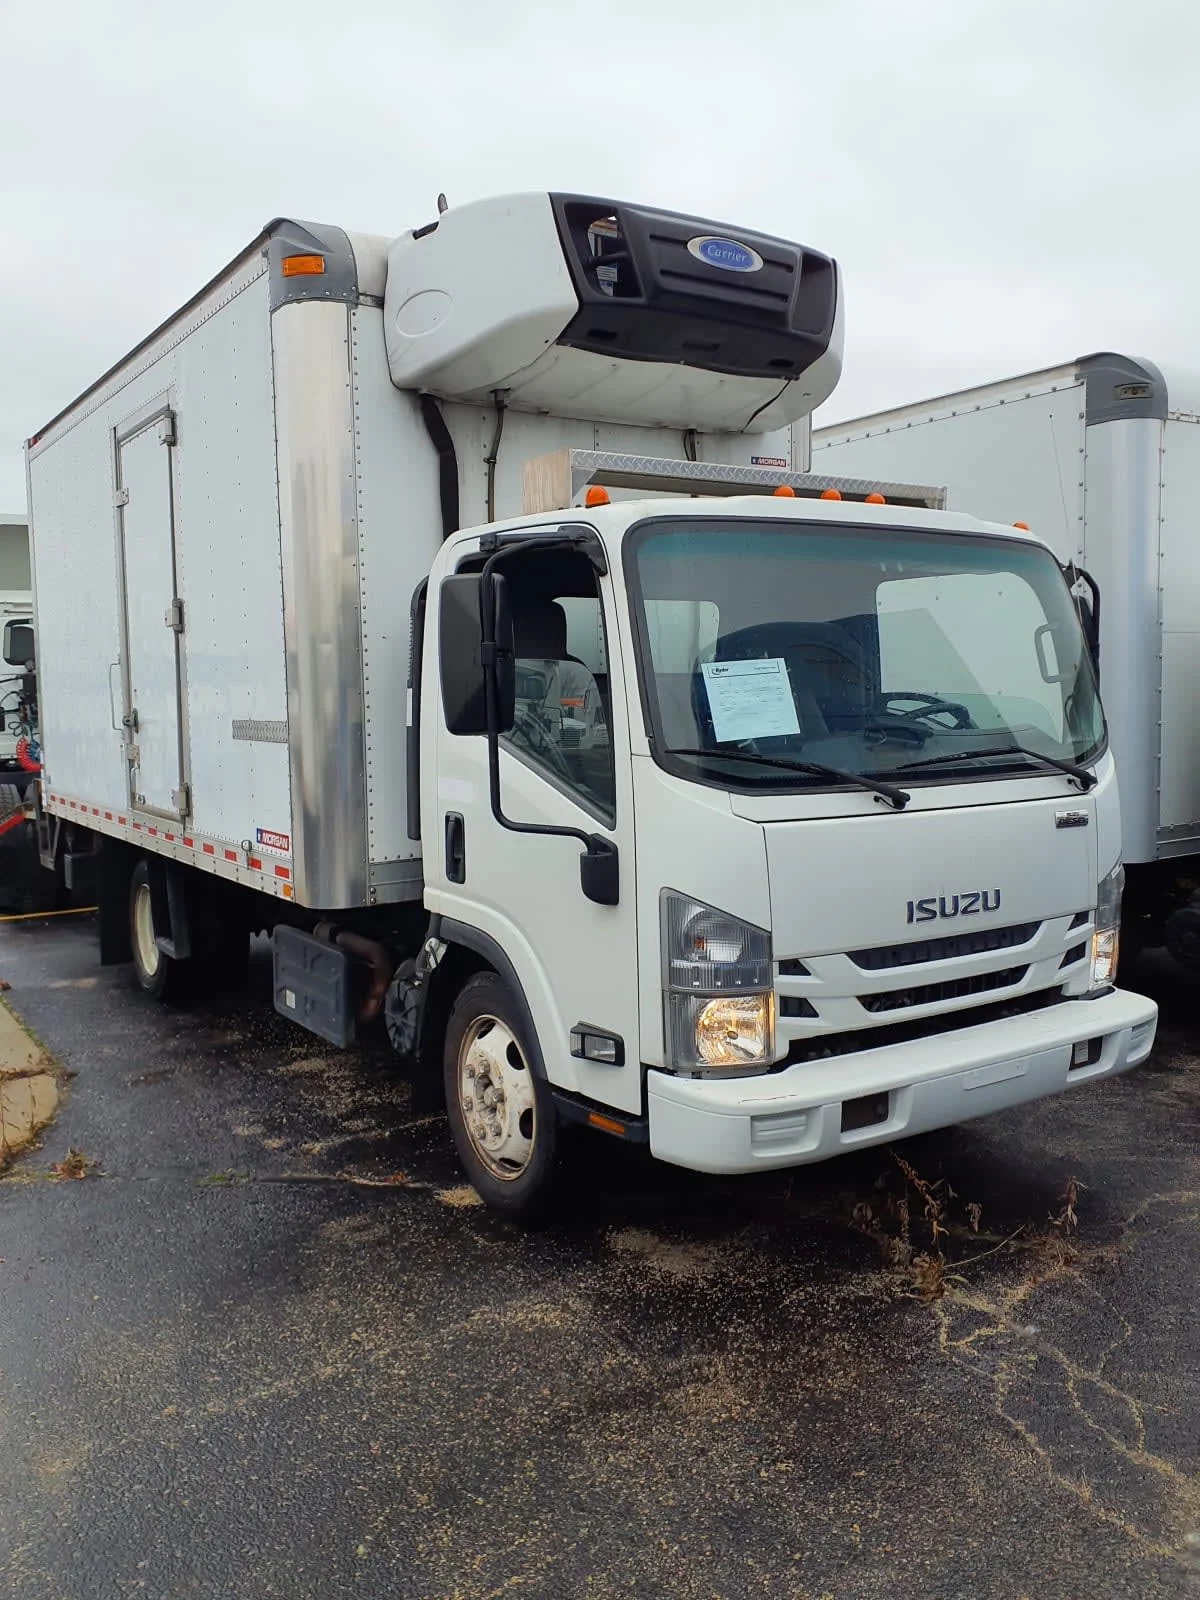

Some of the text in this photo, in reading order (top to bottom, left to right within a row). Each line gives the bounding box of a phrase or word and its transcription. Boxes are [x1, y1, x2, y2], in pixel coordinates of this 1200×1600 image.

[707, 245, 747, 263] Carrier
[757, 458, 785, 467] MORGAN
[262, 831, 288, 850] MORGAN
[906, 887, 1001, 924] ISUZU
